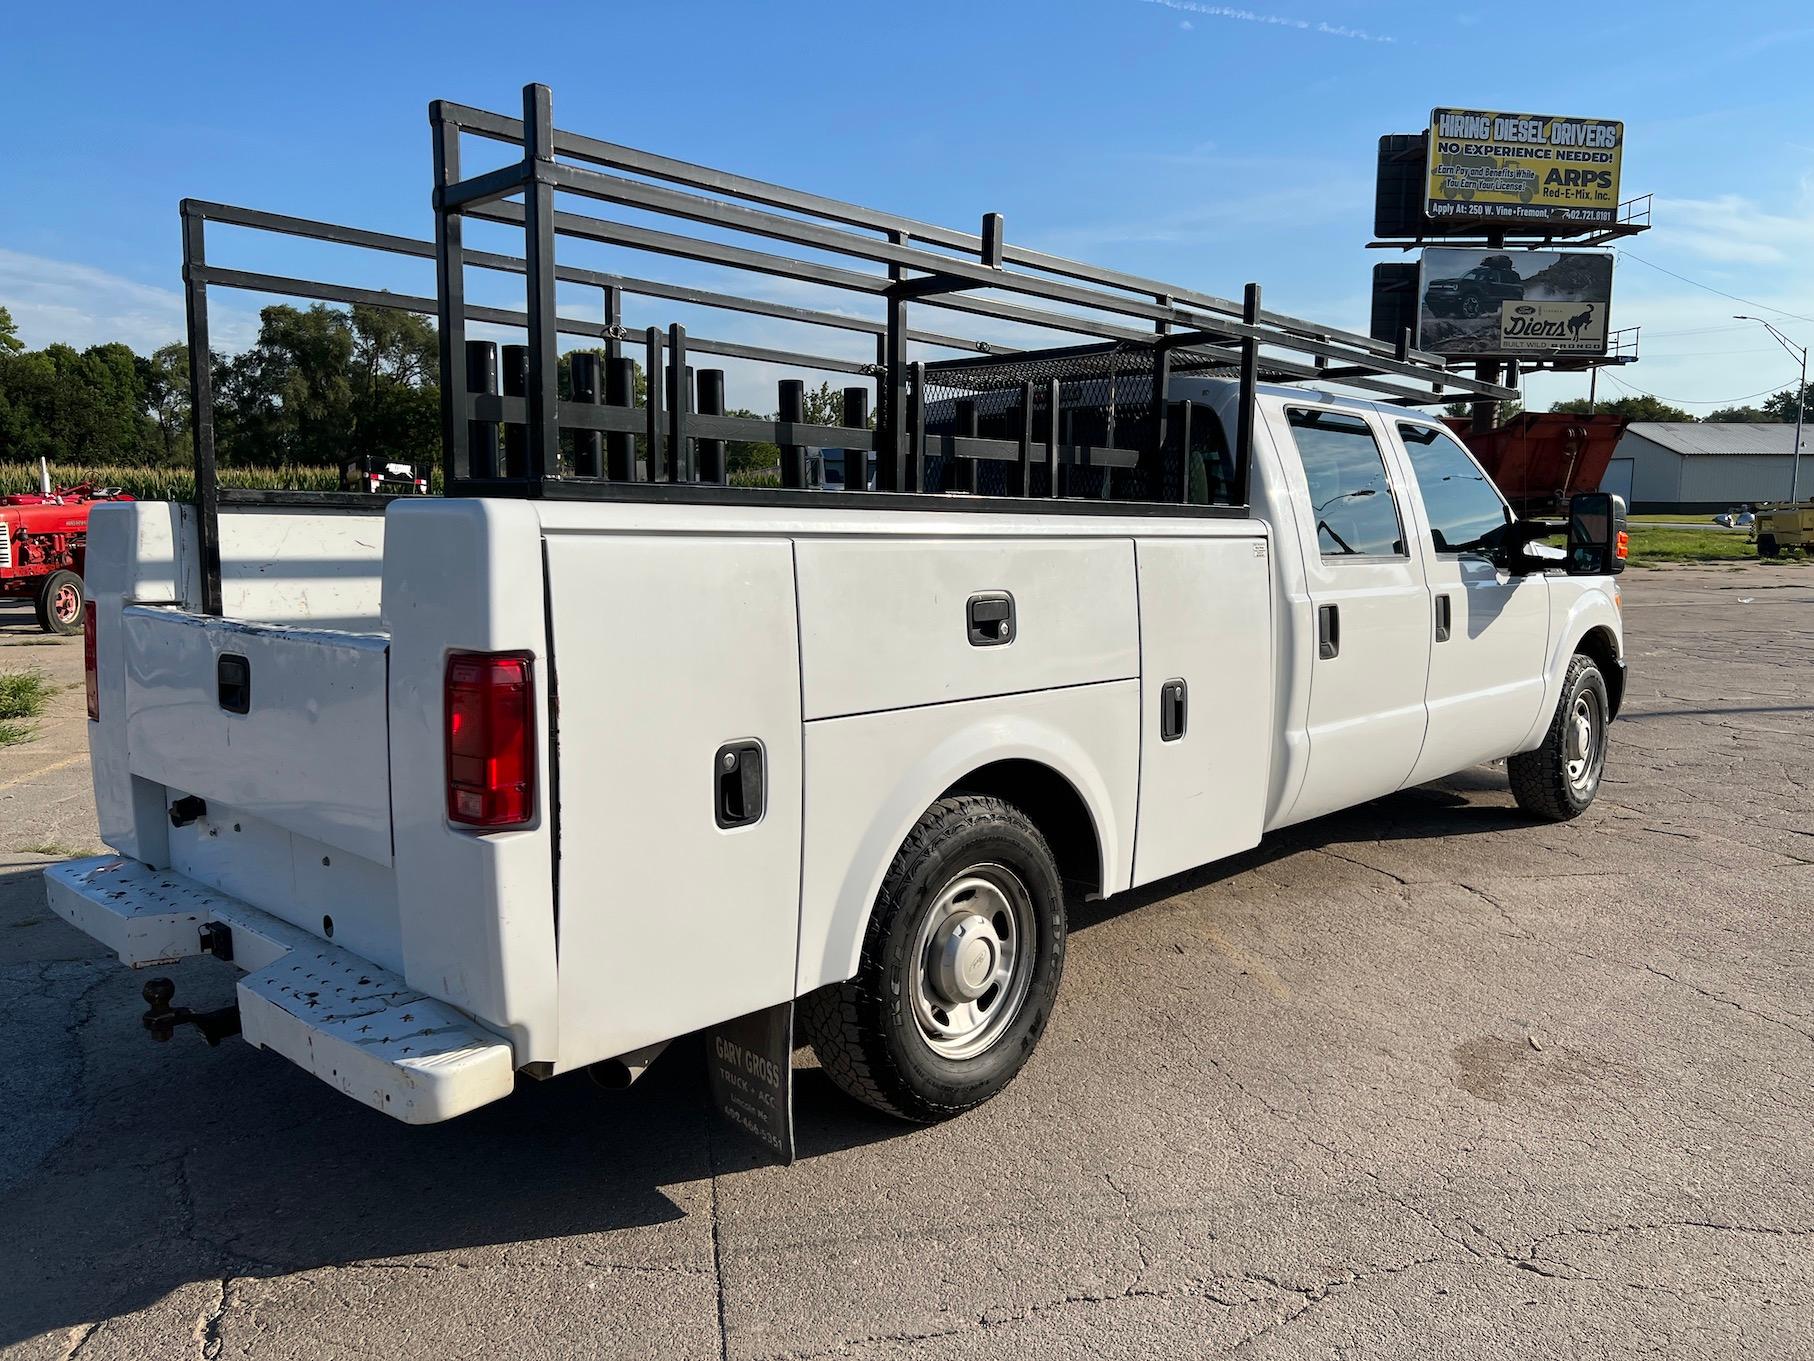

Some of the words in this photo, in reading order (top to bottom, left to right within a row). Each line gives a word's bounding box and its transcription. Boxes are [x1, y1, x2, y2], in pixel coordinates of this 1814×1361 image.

[1439, 114, 1490, 140] HIRING
[1494, 118, 1546, 144] DIESEL
[1551, 122, 1616, 148] DRIVERS
[1438, 142, 1460, 154] NO
[1464, 143, 1552, 160] EXPERIENCE
[1556, 150, 1613, 163] NEEDED!
[1437, 165, 1454, 174] Earn
[1455, 166, 1469, 177] Pay
[1469, 167, 1483, 176] and
[1484, 167, 1514, 178] Benefits
[1515, 169, 1535, 179] While
[1544, 167, 1612, 189] ARPS
[1446, 179, 1458, 188] You
[1460, 180, 1477, 190] Earn
[1478, 180, 1494, 190] Your
[1495, 181, 1525, 191] License!
[1543, 187, 1593, 200] Red-E-Mix,
[1594, 189, 1611, 201] Inc.
[1432, 203, 1454, 216] Apply
[1455, 204, 1468, 214] At:
[1468, 204, 1483, 214] 250
[1484, 205, 1494, 215] W.
[1504, 316, 1566, 336] Diers
[715, 1036, 742, 1067] GARY
[745, 1049, 780, 1088] GROSS
[719, 1067, 748, 1092] TRUCK
[758, 1090, 776, 1108] ACC
